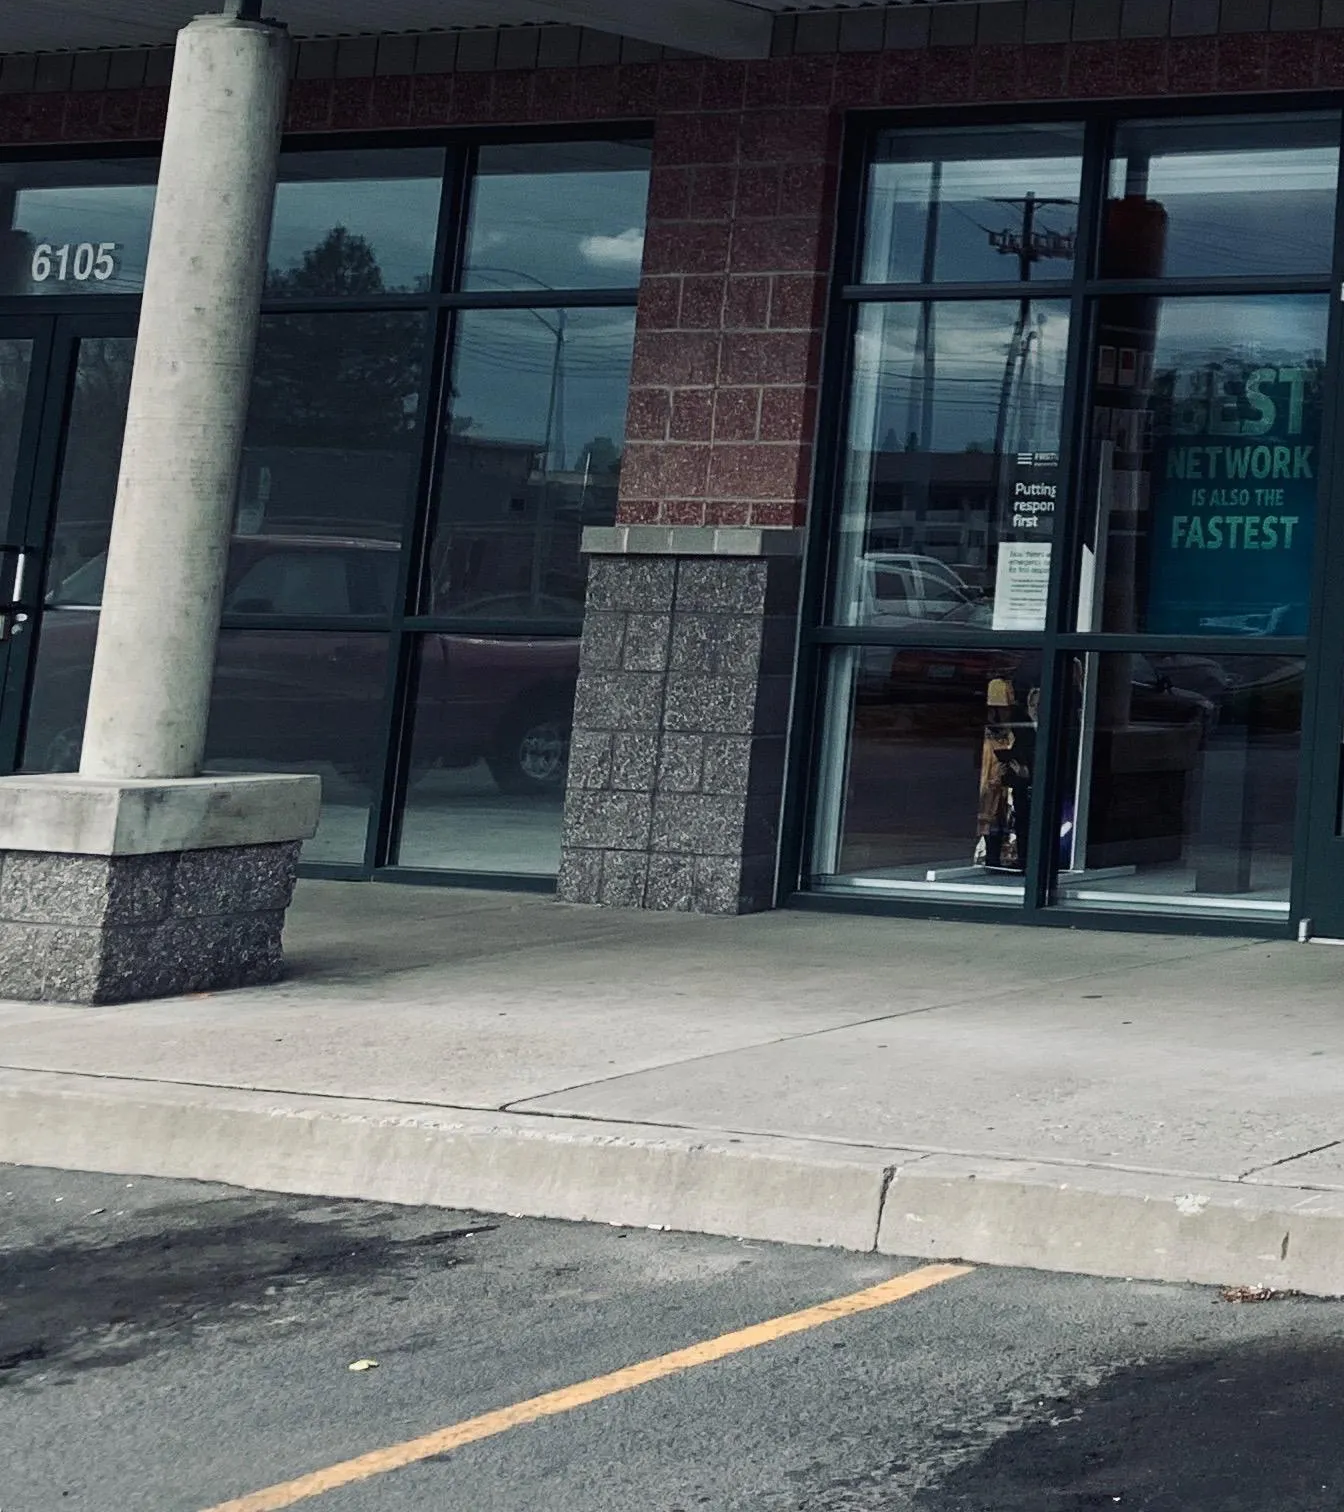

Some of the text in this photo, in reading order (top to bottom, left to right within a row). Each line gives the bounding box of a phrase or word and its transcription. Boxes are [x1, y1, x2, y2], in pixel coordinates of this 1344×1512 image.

[31, 242, 116, 282] 6105
[1166, 445, 1314, 479] NETWORK
[1191, 488, 1284, 506] IS ALSO THE
[1012, 514, 1039, 528] first
[1171, 515, 1300, 550] FASTEST
